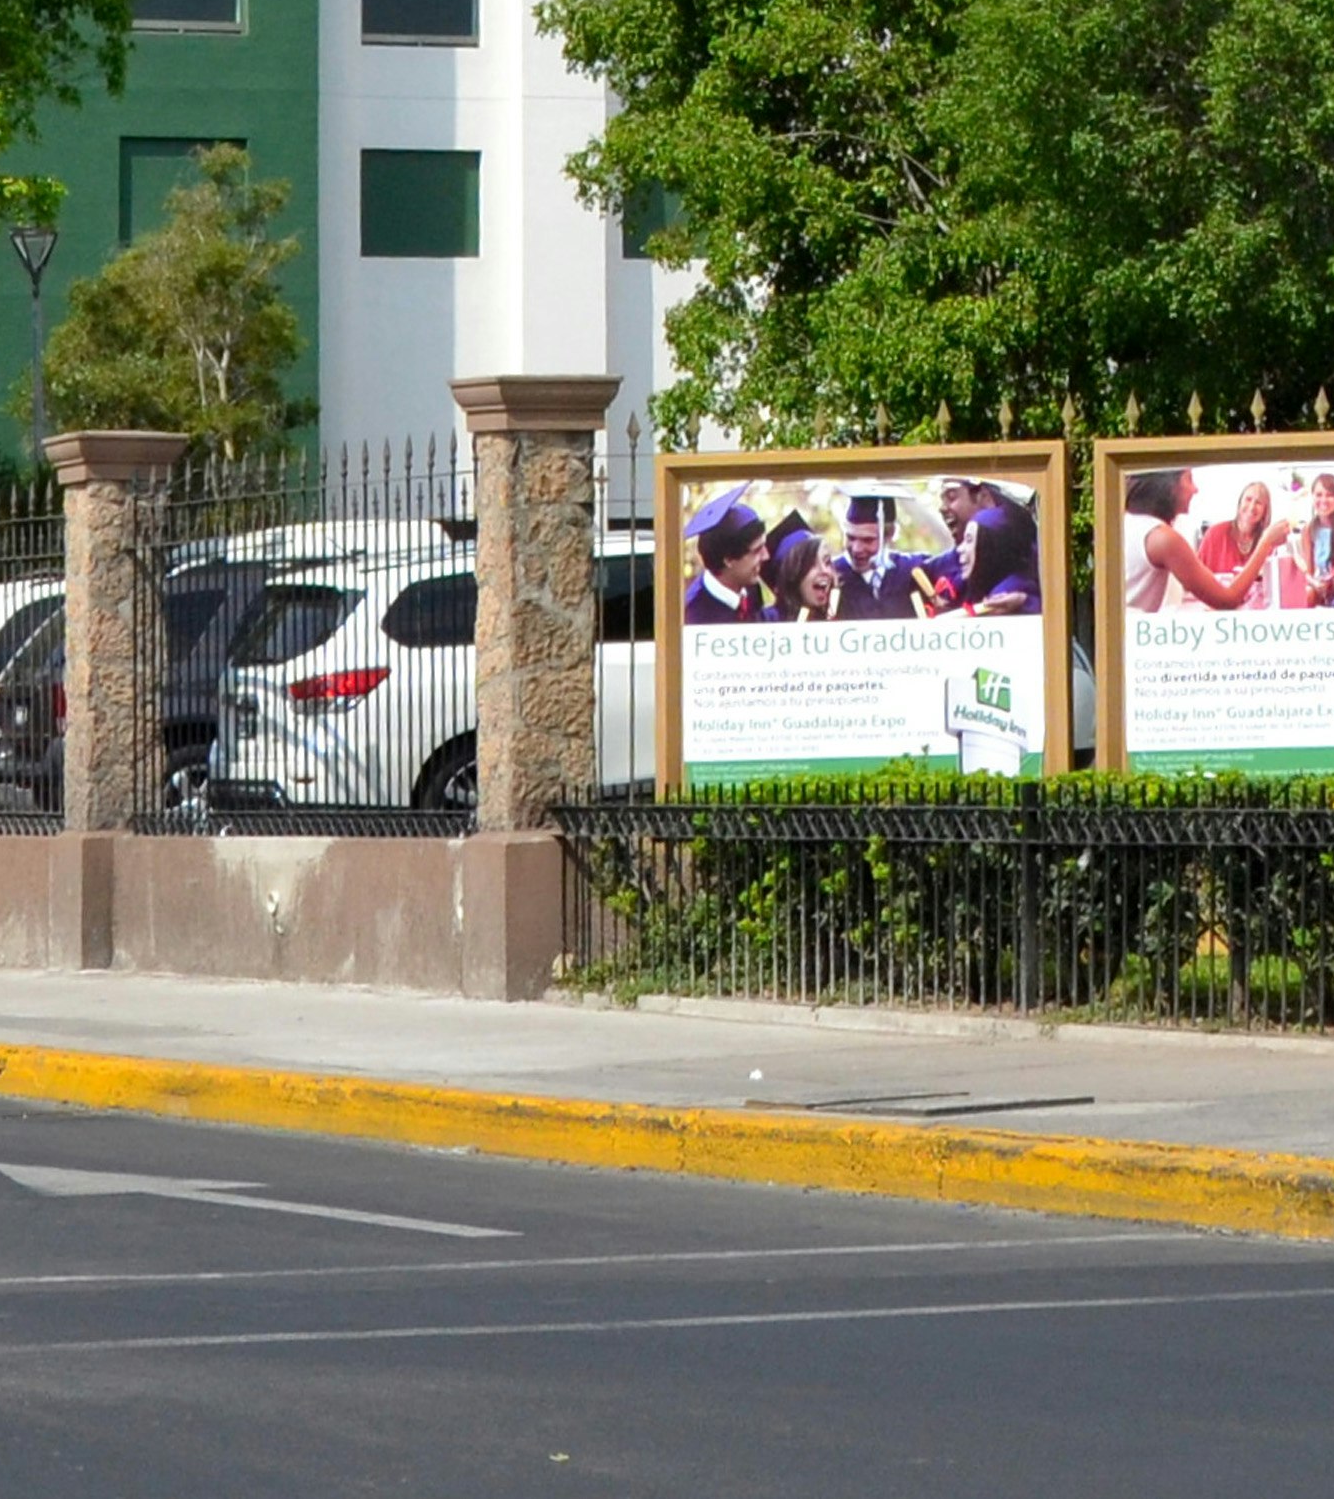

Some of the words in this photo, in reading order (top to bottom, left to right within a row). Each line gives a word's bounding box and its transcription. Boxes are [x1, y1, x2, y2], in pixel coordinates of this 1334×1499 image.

[695, 631, 792, 662] Festeja
[803, 633, 829, 654] tu
[839, 625, 1004, 654] Graduación
[1136, 619, 1205, 652] Baby
[1160, 672, 1217, 683] divertida
[1221, 669, 1277, 681] variedad
[1280, 669, 1296, 680] de
[718, 685, 746, 697] gran
[750, 681, 804, 694] variedad
[807, 681, 822, 692] de
[954, 704, 1008, 732] Holiday
[1009, 719, 1027, 738] Inn
[1134, 707, 1188, 722] Holiday
[1226, 704, 1314, 720] Guadalajara
[693, 718, 745, 732] Holiday
[782, 715, 867, 731] Guadalajara
[872, 714, 906, 729] Expo
